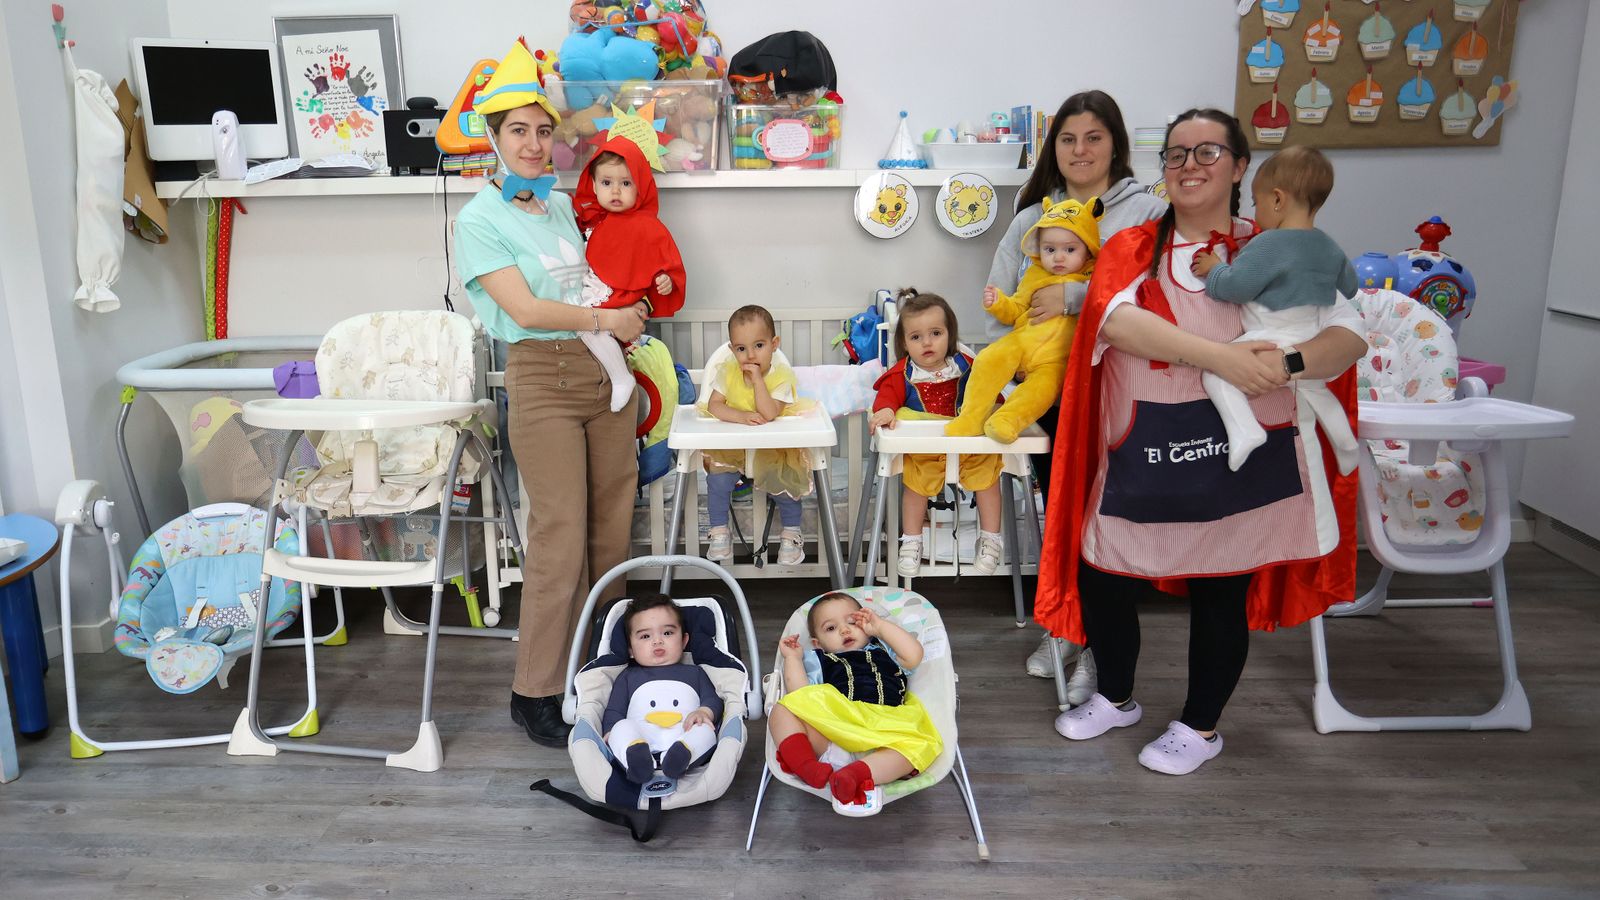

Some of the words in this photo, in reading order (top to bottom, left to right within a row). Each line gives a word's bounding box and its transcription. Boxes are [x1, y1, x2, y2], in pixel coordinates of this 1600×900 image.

[296, 46, 303, 55] A
[1168, 440, 1191, 448] Escuela
[1191, 437, 1213, 446] Infantil
